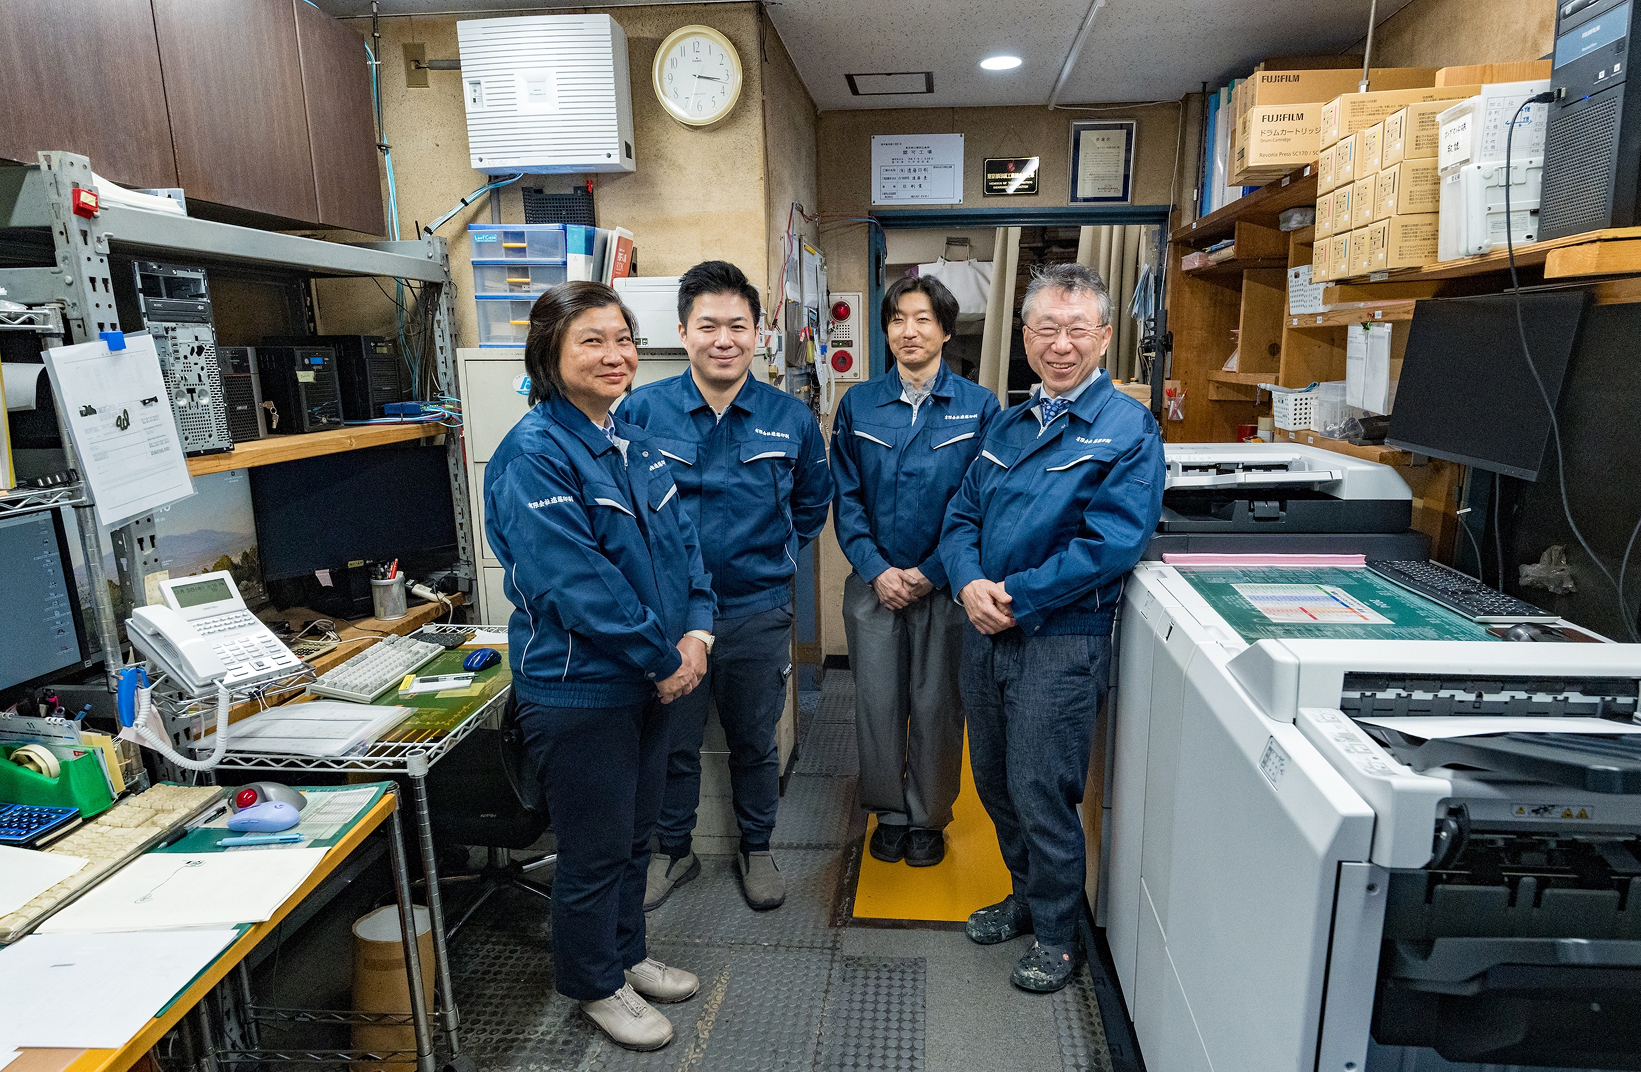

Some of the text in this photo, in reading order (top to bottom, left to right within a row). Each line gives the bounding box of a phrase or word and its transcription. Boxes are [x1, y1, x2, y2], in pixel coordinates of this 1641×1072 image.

[680, 45, 686, 57] 11
[692, 40, 700, 53] 12
[708, 44, 712, 56] 1
[670, 56, 678, 69] 10
[719, 53, 724, 66] 2
[667, 73, 673, 85] 9
[725, 69, 729, 81] 3
[1261, 74, 1300, 83] FUJIFILM
[673, 87, 679, 99] 8
[720, 85, 725, 97] 4
[684, 97, 689, 109] 7
[697, 99, 703, 112] 6
[711, 96, 716, 107] 5
[1261, 113, 1304, 123] FUJIFILM
[1260, 127, 1321, 137] ドラムカートリッジ
